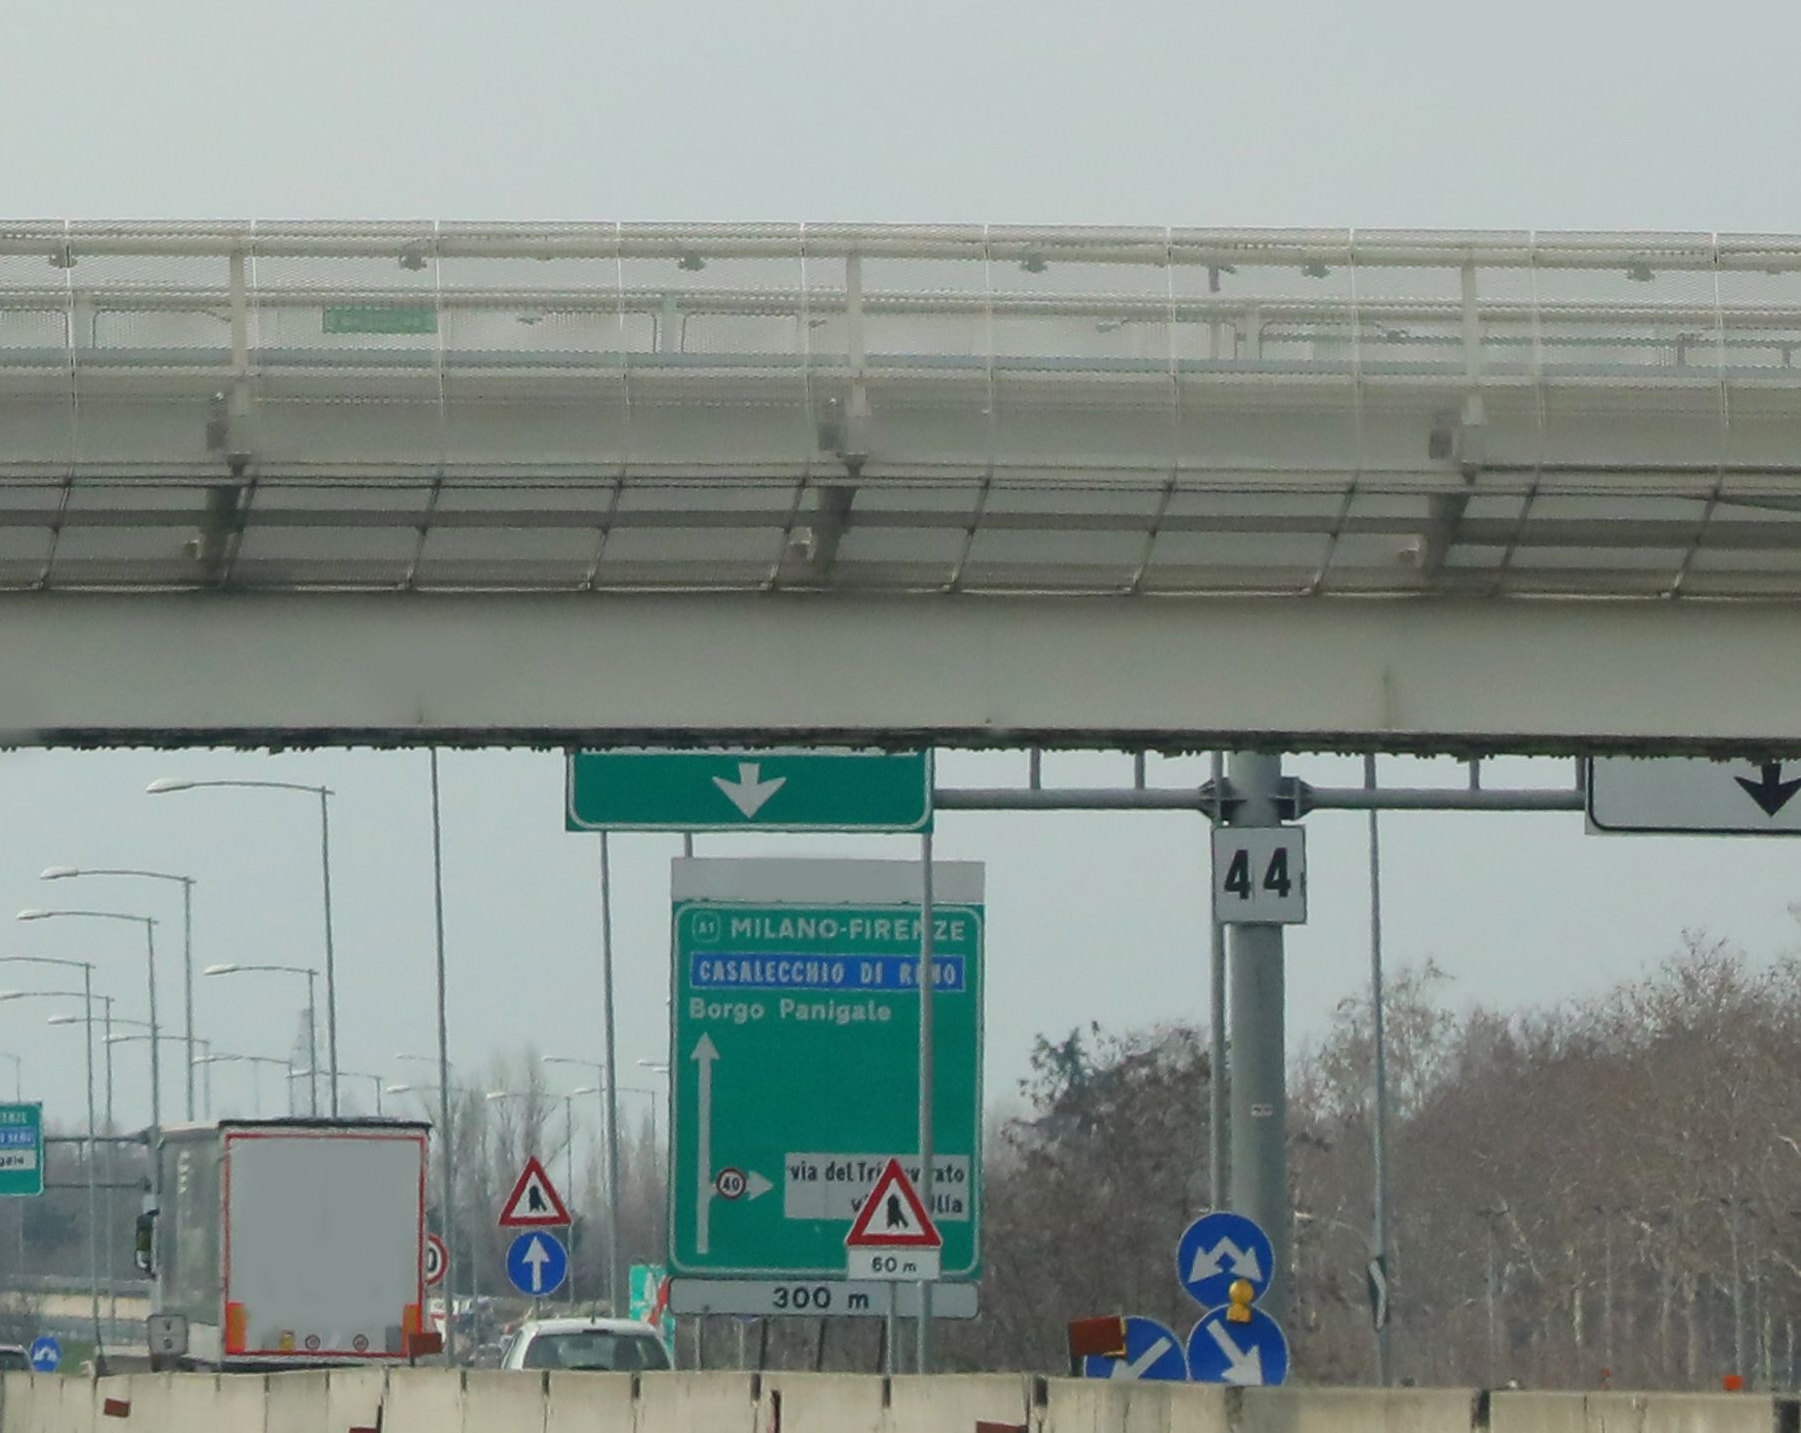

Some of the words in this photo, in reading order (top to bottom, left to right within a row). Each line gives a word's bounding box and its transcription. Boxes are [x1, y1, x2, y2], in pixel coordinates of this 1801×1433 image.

[1224, 846, 1292, 900] 44
[730, 917, 966, 942] MILANO-FIRENZE
[700, 959, 846, 984] CASALECCHIO
[860, 961, 884, 984] DI
[688, 996, 766, 1025] Borgo
[779, 997, 892, 1025] Panigale
[788, 1165, 817, 1182] via
[825, 1161, 854, 1182] del
[871, 1255, 897, 1273] 60
[772, 1286, 832, 1309] 300
[847, 1292, 870, 1309] m
